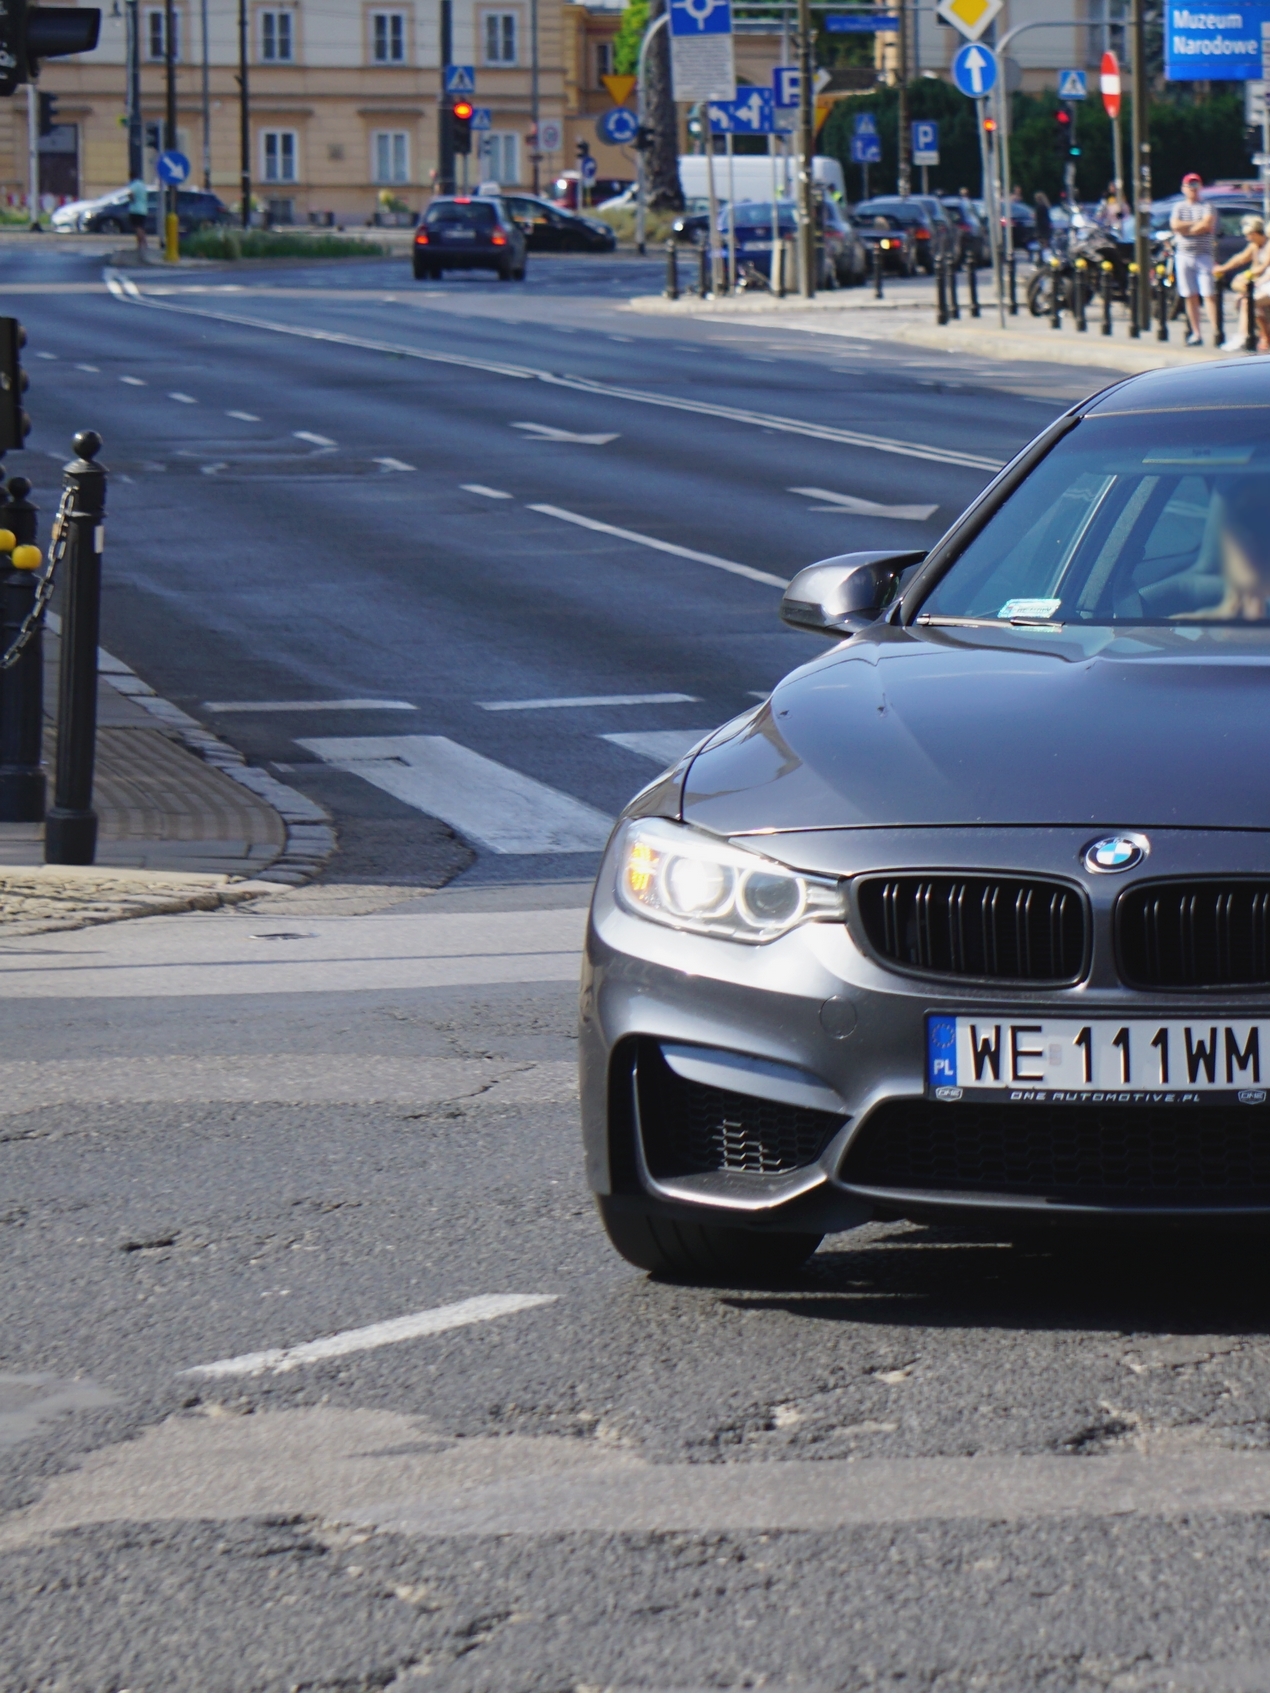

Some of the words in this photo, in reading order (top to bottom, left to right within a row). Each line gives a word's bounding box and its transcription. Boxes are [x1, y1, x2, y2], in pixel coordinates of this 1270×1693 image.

[1173, 10, 1243, 29] Muzeum
[1173, 35, 1258, 55] Narodowe
[918, 126, 933, 149] P
[969, 1024, 1044, 1081] WE
[1073, 1026, 1260, 1084] 111WM
[933, 1059, 954, 1075] PL
[1010, 1091, 1046, 1100] ONE
[1052, 1091, 1200, 1102] AUTOMOTIVE.PL
